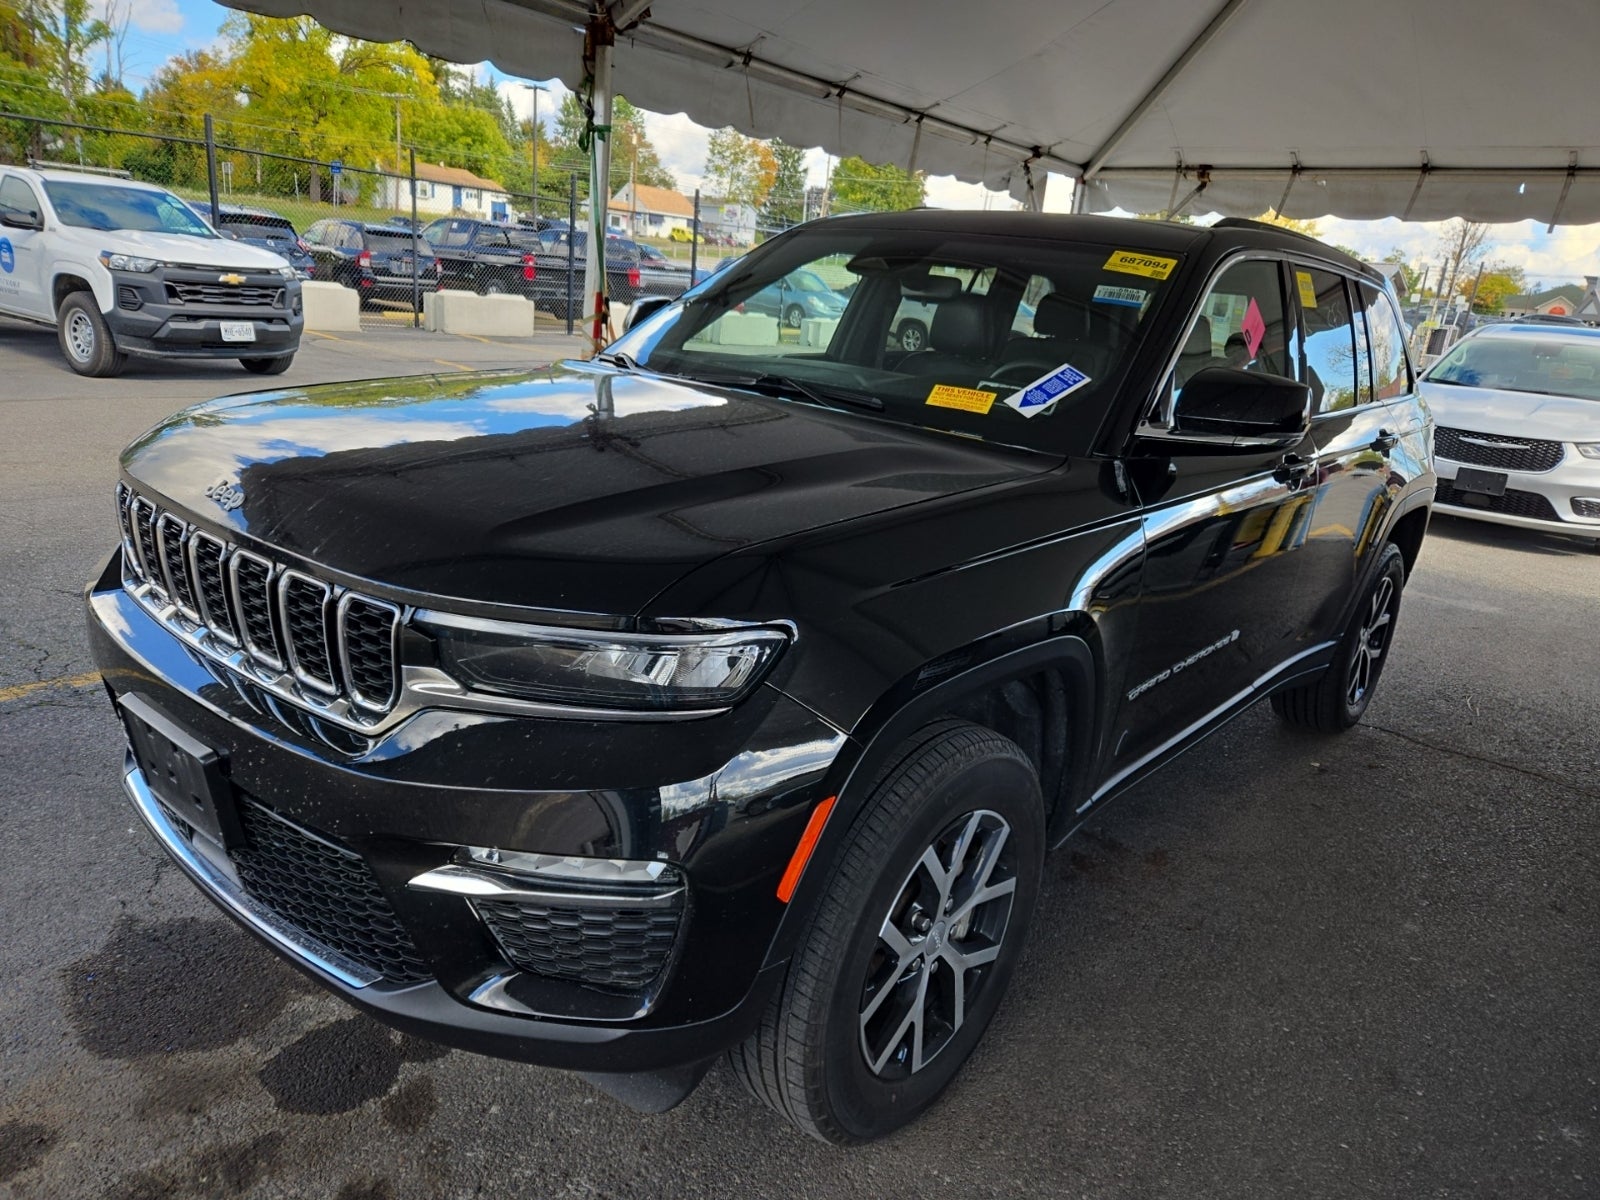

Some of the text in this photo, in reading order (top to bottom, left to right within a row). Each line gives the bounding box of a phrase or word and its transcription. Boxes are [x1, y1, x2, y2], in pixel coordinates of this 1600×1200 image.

[1120, 256, 1169, 270] 687094
[957, 389, 991, 399] VEHICLE
[205, 480, 246, 511] Jeep
[1126, 635, 1232, 701] GRAND CHEROKEE
